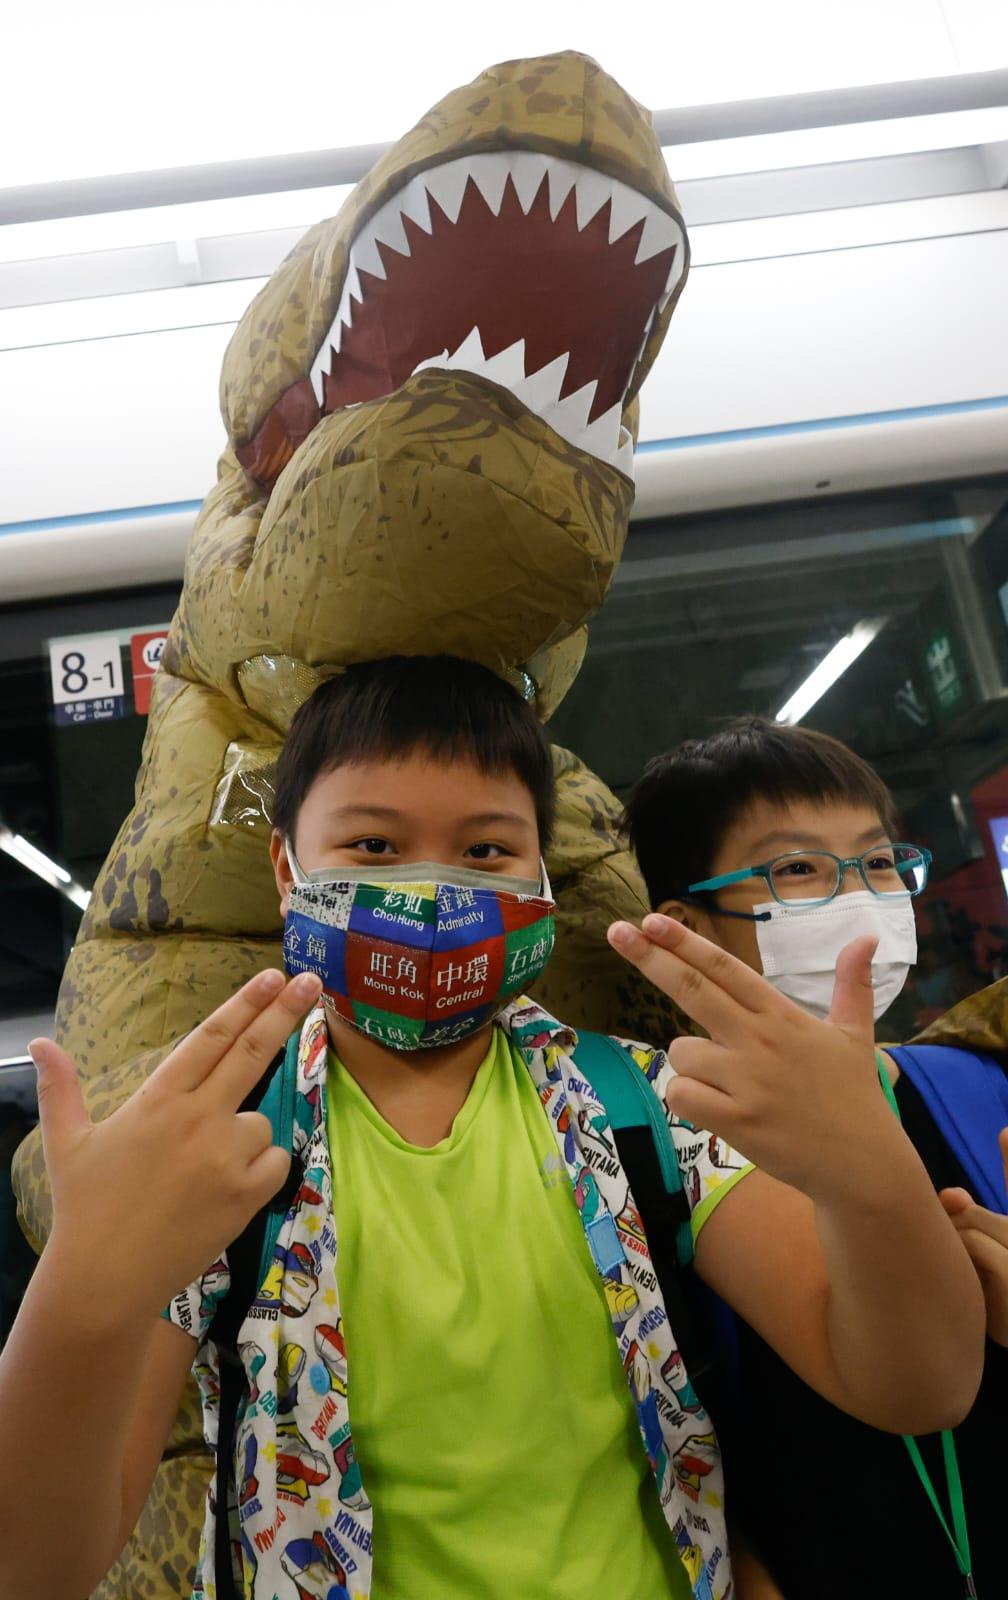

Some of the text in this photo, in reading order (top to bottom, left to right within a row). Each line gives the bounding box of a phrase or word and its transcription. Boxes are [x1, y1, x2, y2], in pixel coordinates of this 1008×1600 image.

[62, 652, 114, 694] 8-1
[320, 894, 337, 909] Tei
[382, 888, 422, 915] 彩虹
[372, 907, 425, 931] Choi Hung
[437, 910, 484, 932] Admiralty
[284, 925, 326, 963] 金鐘
[509, 934, 555, 973] 石硤
[370, 951, 416, 984] 旺角
[437, 953, 489, 991] 中環
[364, 976, 424, 1001] Mong Kok
[436, 986, 484, 1009] Central
